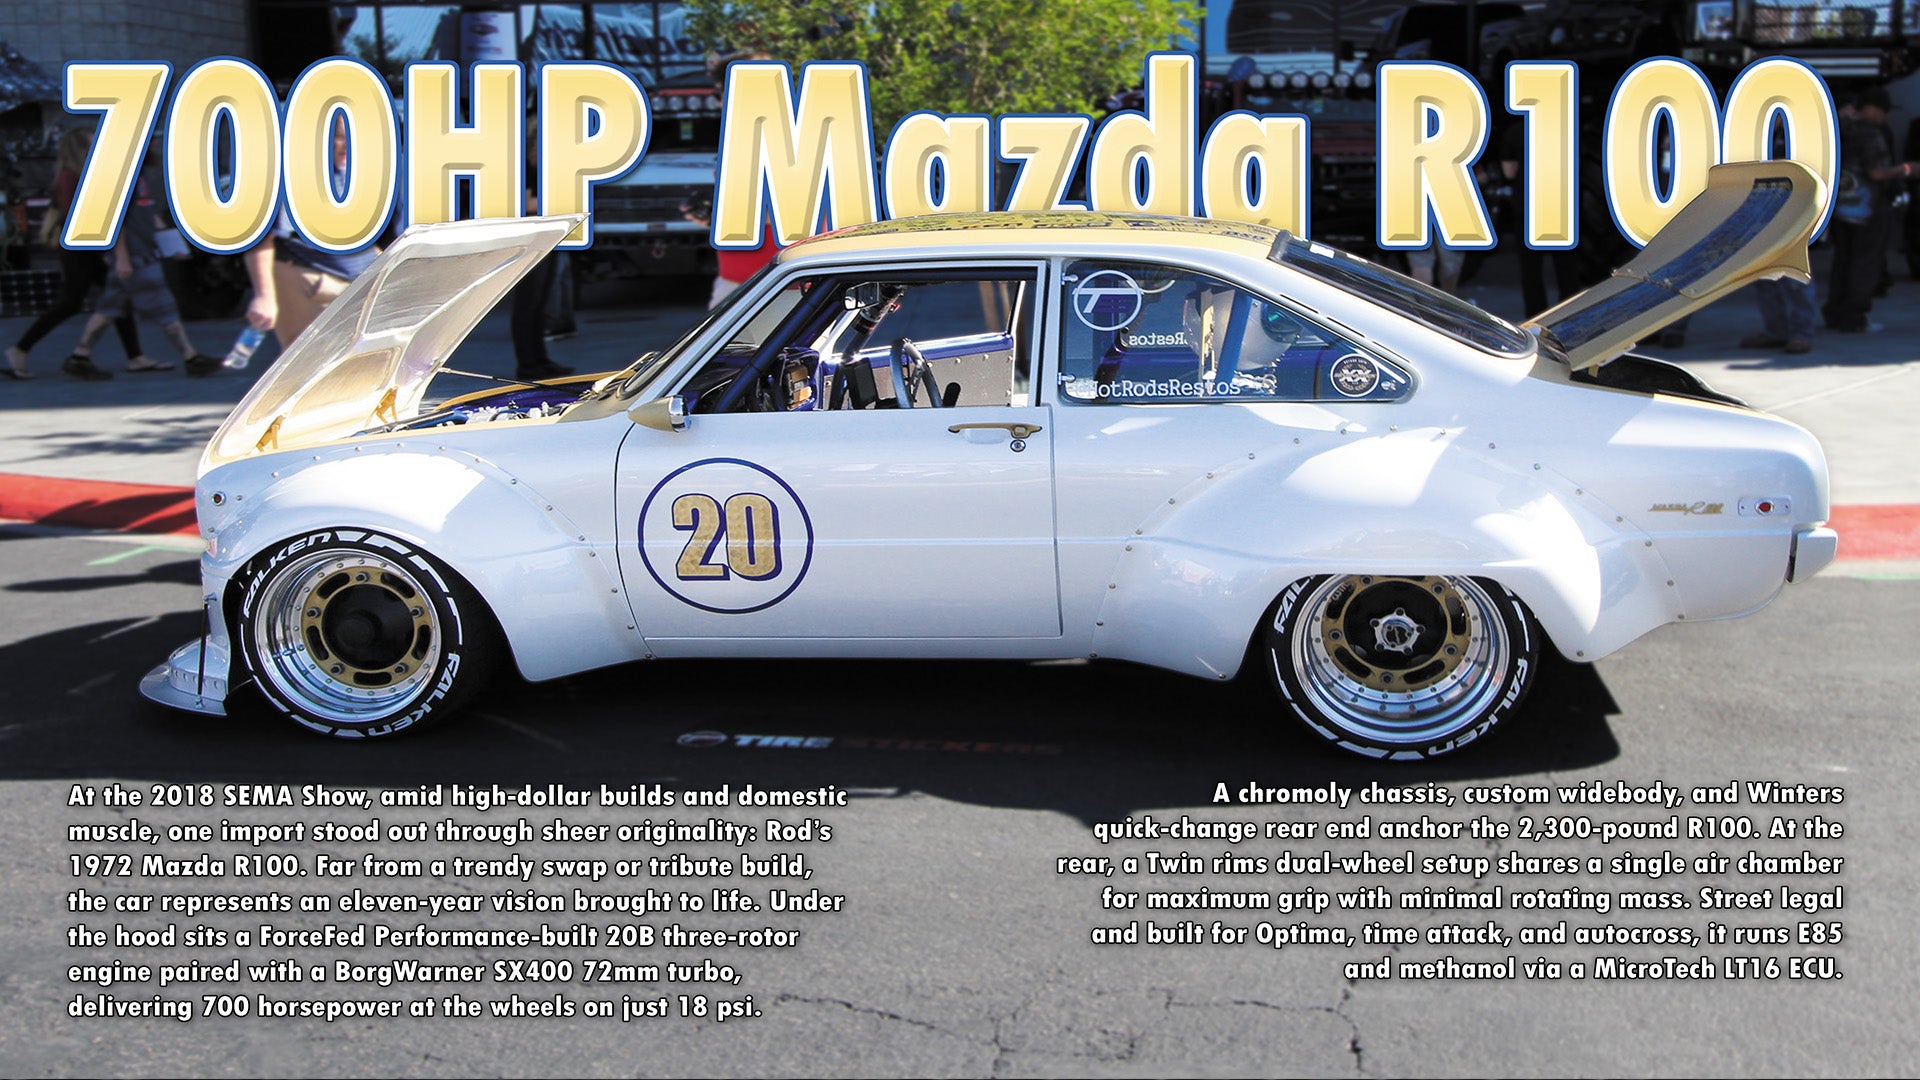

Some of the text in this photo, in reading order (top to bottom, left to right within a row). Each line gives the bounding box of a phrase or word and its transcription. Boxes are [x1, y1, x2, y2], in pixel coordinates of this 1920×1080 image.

[242, 532, 332, 619] FALKEN
[671, 492, 783, 581] 20
[1273, 574, 1316, 634] FAL
[367, 652, 461, 738] FALKEN
[1428, 657, 1529, 757] FALKEN
